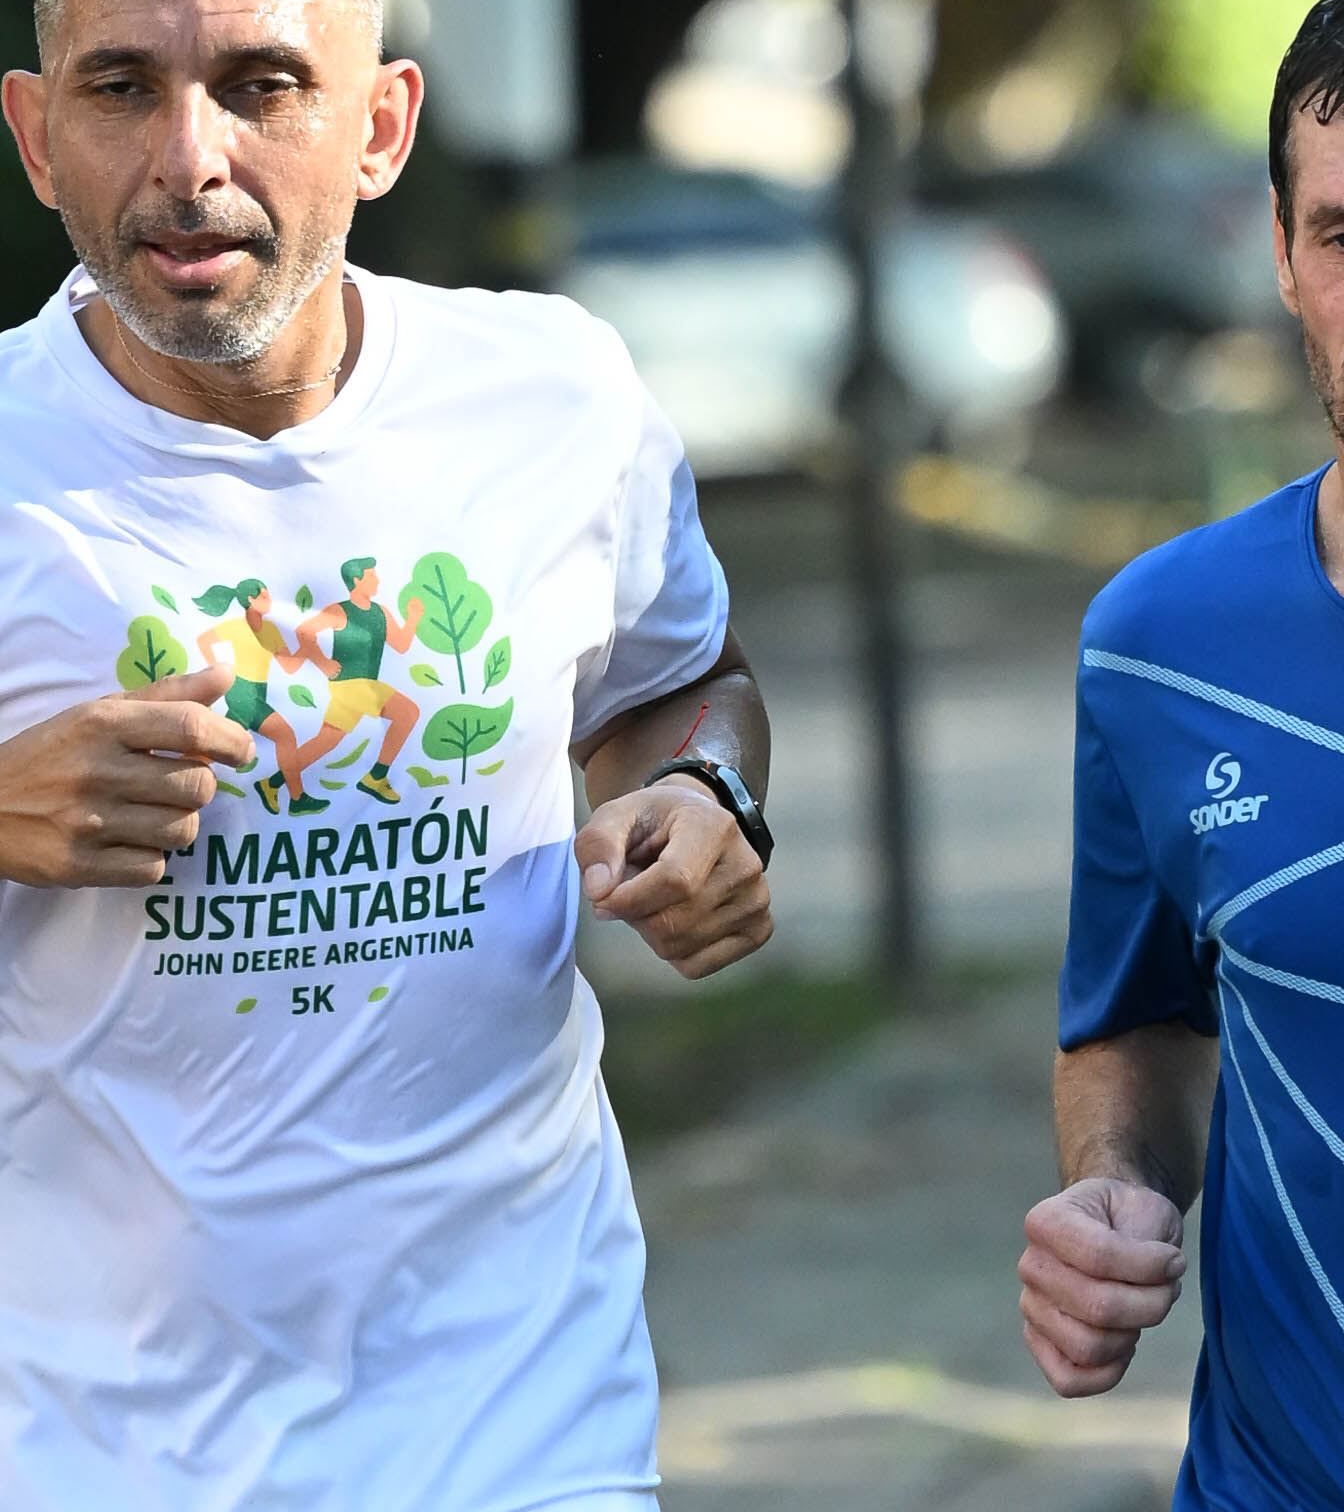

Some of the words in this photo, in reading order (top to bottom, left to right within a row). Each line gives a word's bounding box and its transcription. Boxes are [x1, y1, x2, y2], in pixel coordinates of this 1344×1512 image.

[205, 795, 490, 886] MARATÓN
[143, 865, 487, 941] SUSTENTABLE
[153, 951, 224, 976] JOHN
[232, 945, 318, 974] DEERE
[323, 926, 476, 966] ARGENTINA
[290, 983, 336, 1016] 5K
